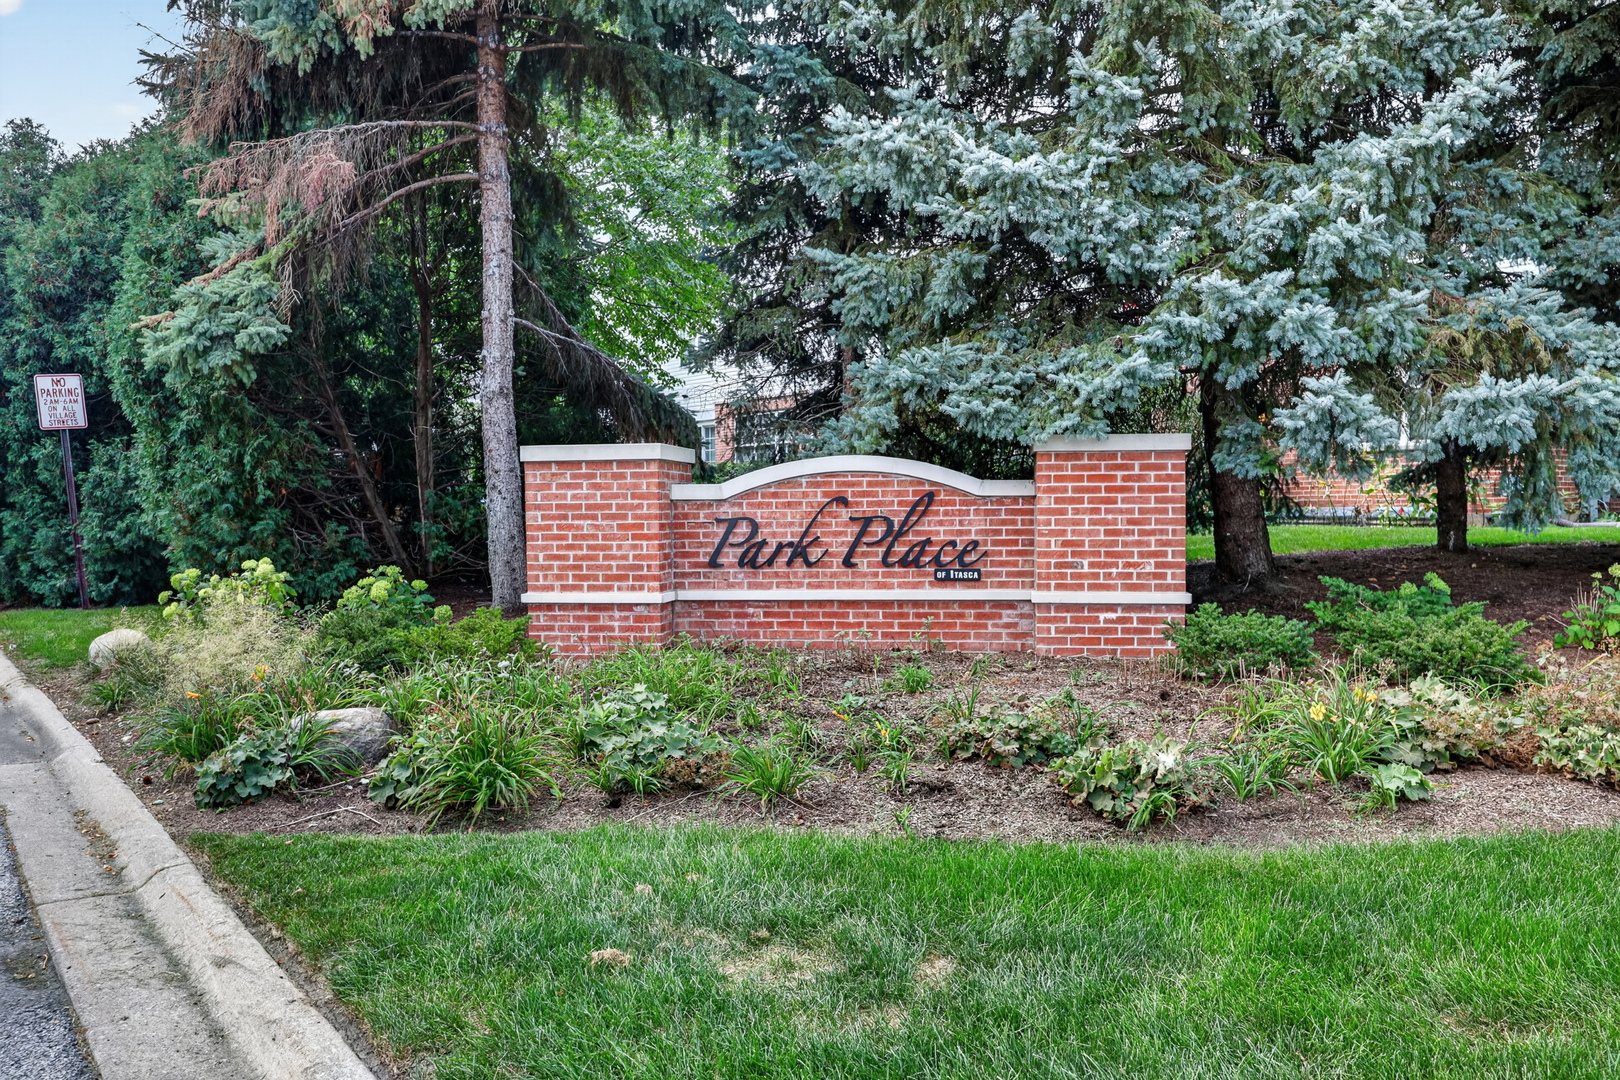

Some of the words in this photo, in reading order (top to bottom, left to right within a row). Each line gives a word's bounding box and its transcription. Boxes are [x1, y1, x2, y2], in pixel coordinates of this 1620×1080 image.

[51, 377, 65, 387] NO
[40, 388, 79, 398] PARKING
[708, 496, 849, 570] Park
[841, 491, 988, 569] Place
